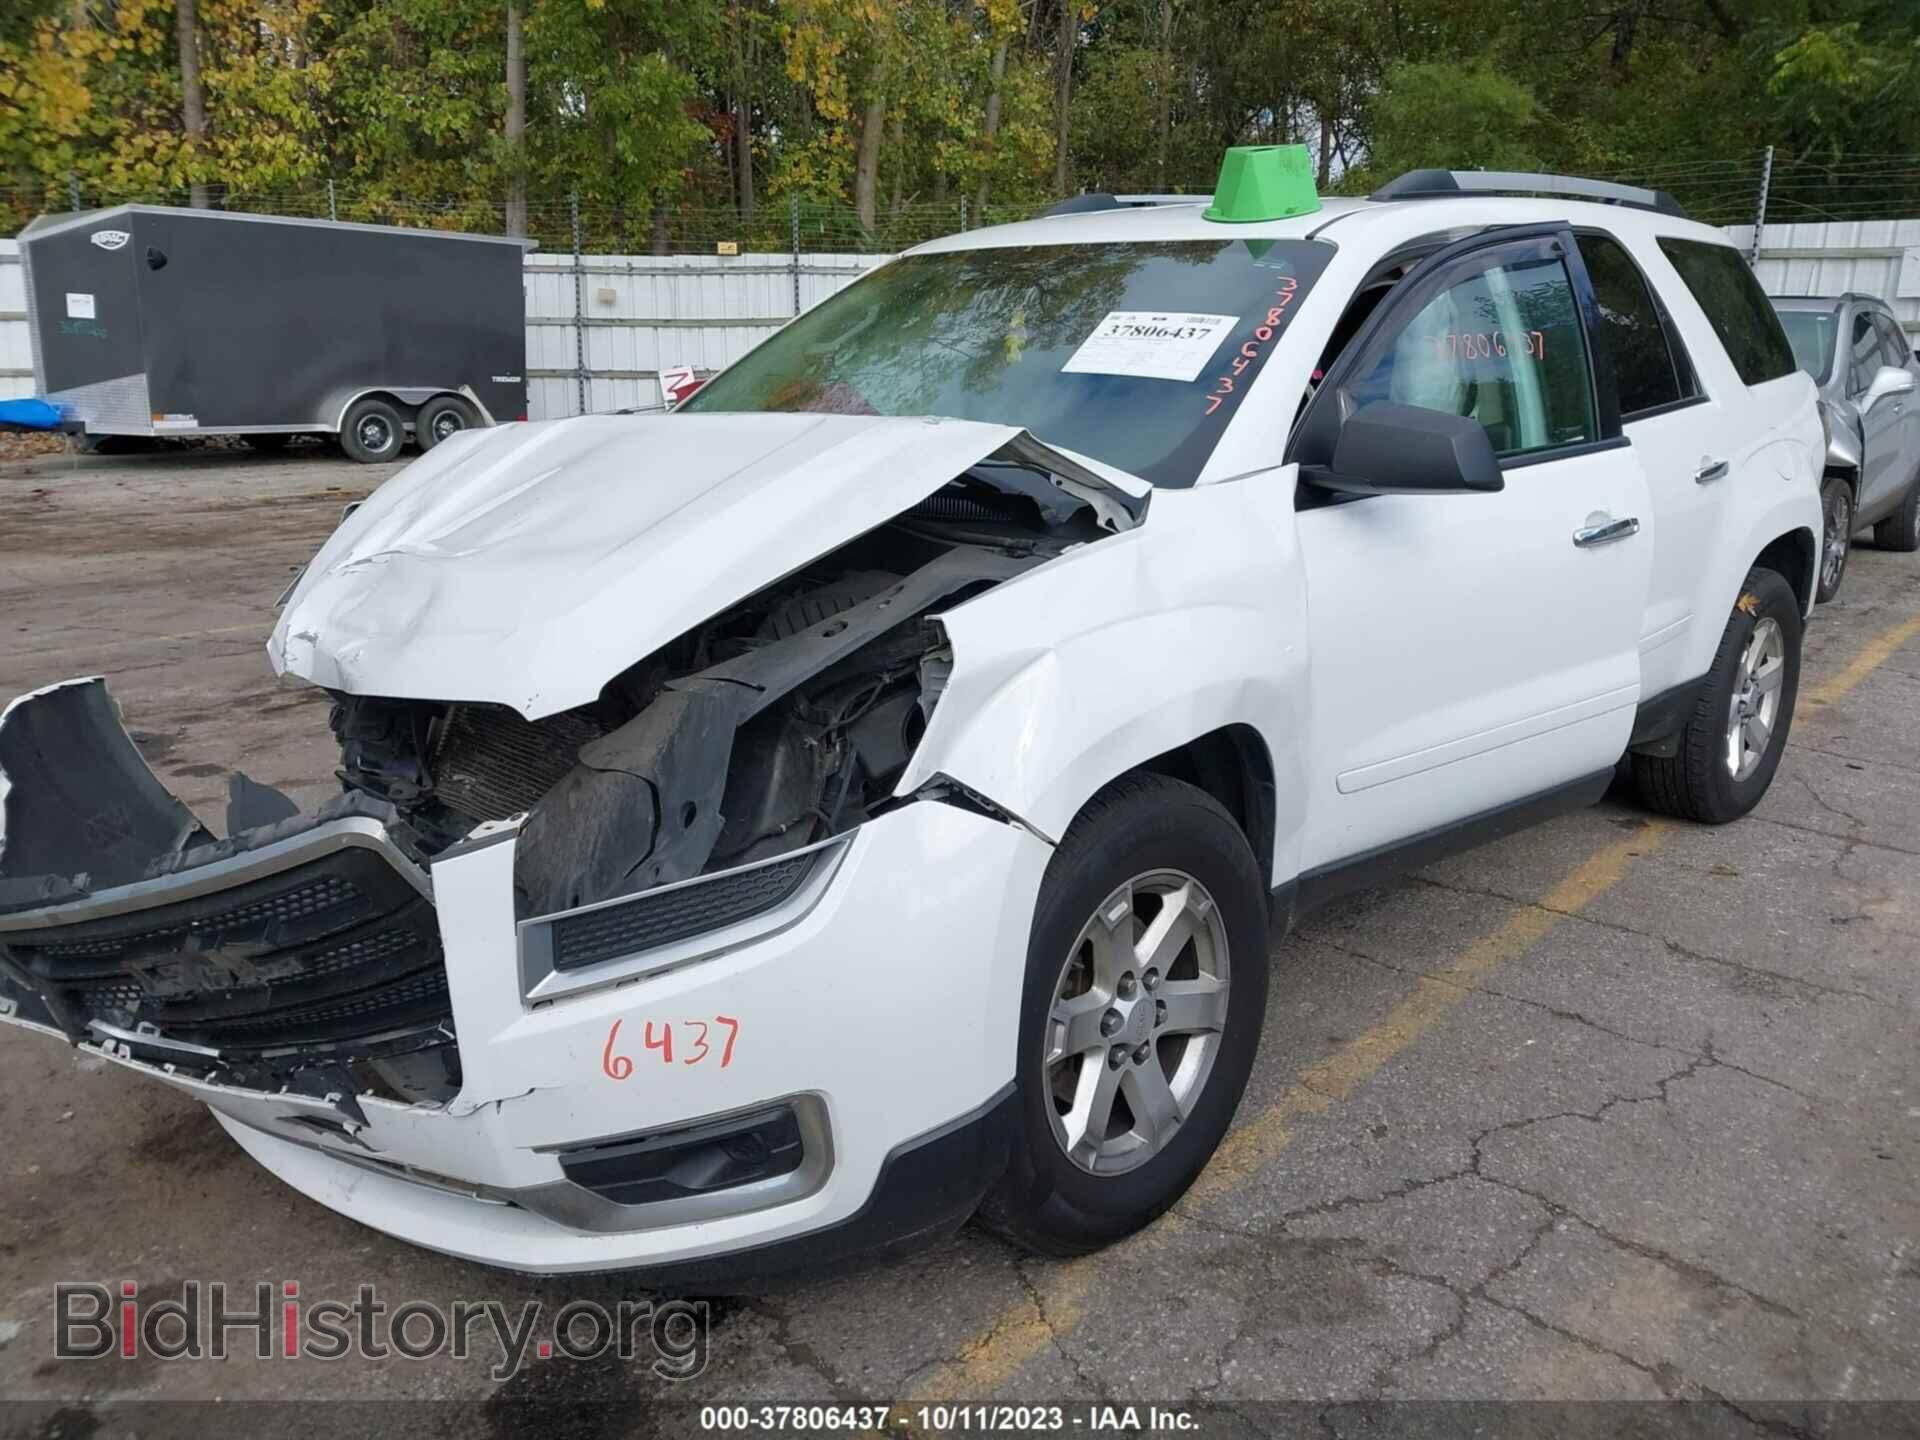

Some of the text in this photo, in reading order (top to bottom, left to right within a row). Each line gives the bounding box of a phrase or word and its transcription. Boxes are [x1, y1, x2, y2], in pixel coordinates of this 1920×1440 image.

[1104, 324, 1211, 340] 37806437
[1205, 276, 1298, 415] 37806437
[603, 1015, 738, 1080] 6437
